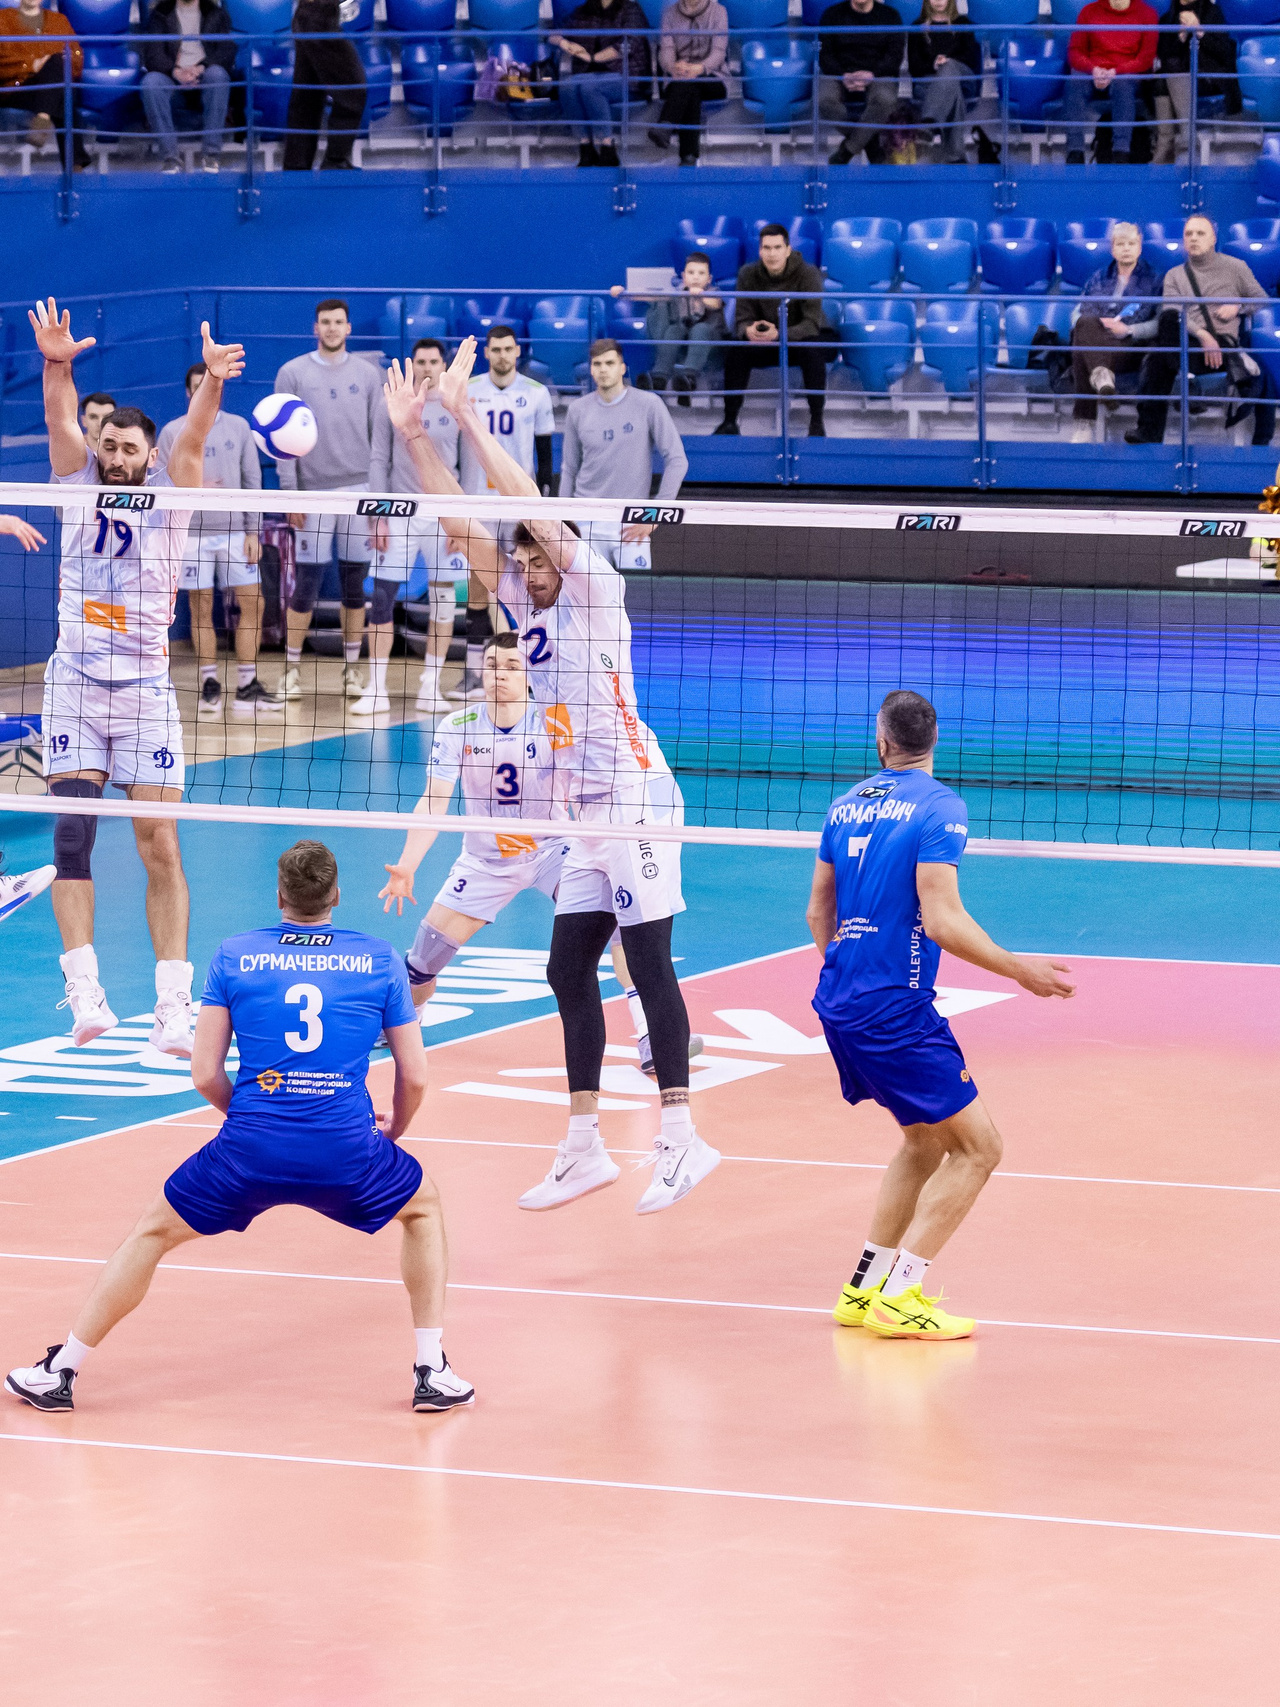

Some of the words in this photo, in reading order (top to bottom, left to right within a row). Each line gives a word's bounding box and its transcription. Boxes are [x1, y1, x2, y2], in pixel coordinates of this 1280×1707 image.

[487, 410, 515, 435] 10
[603, 429, 614, 441] 13
[101, 493, 151, 508] PARI
[361, 501, 412, 515] PARI
[627, 508, 679, 523] PARI
[900, 514, 956, 530] PARI
[93, 510, 134, 559] 19
[1184, 520, 1241, 537] PARI
[522, 627, 552, 667] 2
[51, 734, 70, 754] 19
[473, 746, 492, 756] ФСК
[495, 762, 520, 799] 3
[848, 833, 873, 875] 7
[453, 878, 468, 893] 3
[280, 933, 332, 946] PARI
[239, 952, 373, 975] СУРМАЧЕВСКИЙ
[284, 983, 324, 1053] 3
[286, 1086, 335, 1096] КОМПАНИЯ
